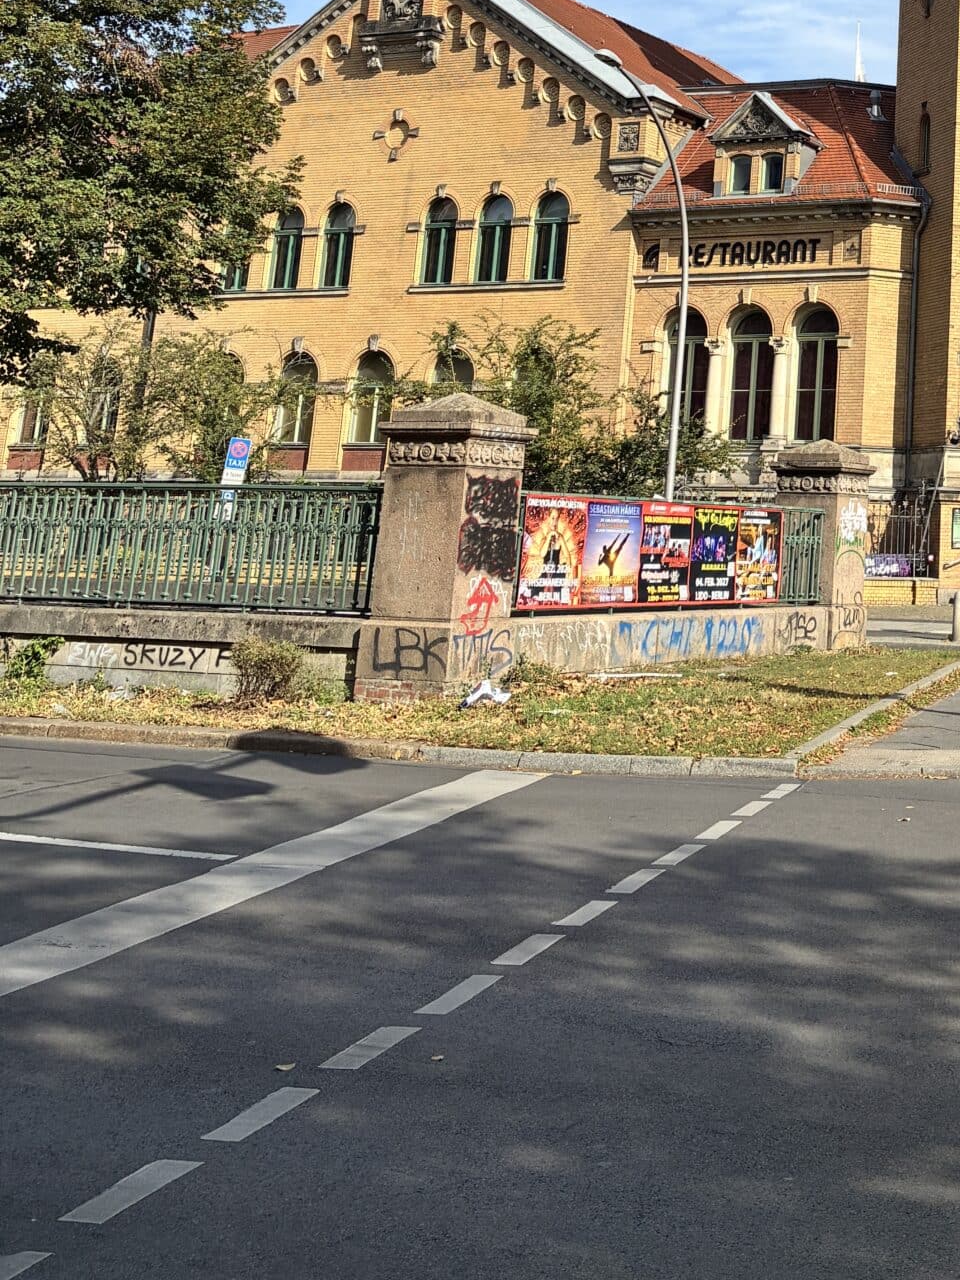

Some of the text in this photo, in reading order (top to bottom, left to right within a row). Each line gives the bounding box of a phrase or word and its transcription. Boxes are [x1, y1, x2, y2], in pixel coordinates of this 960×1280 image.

[679, 238, 821, 268] RESTAURANT
[228, 459, 245, 468] TAXI
[694, 591, 708, 601] LIDO
[711, 591, 730, 600] BERLIN
[123, 643, 206, 670] SKUZY
[373, 627, 448, 679] LBK
